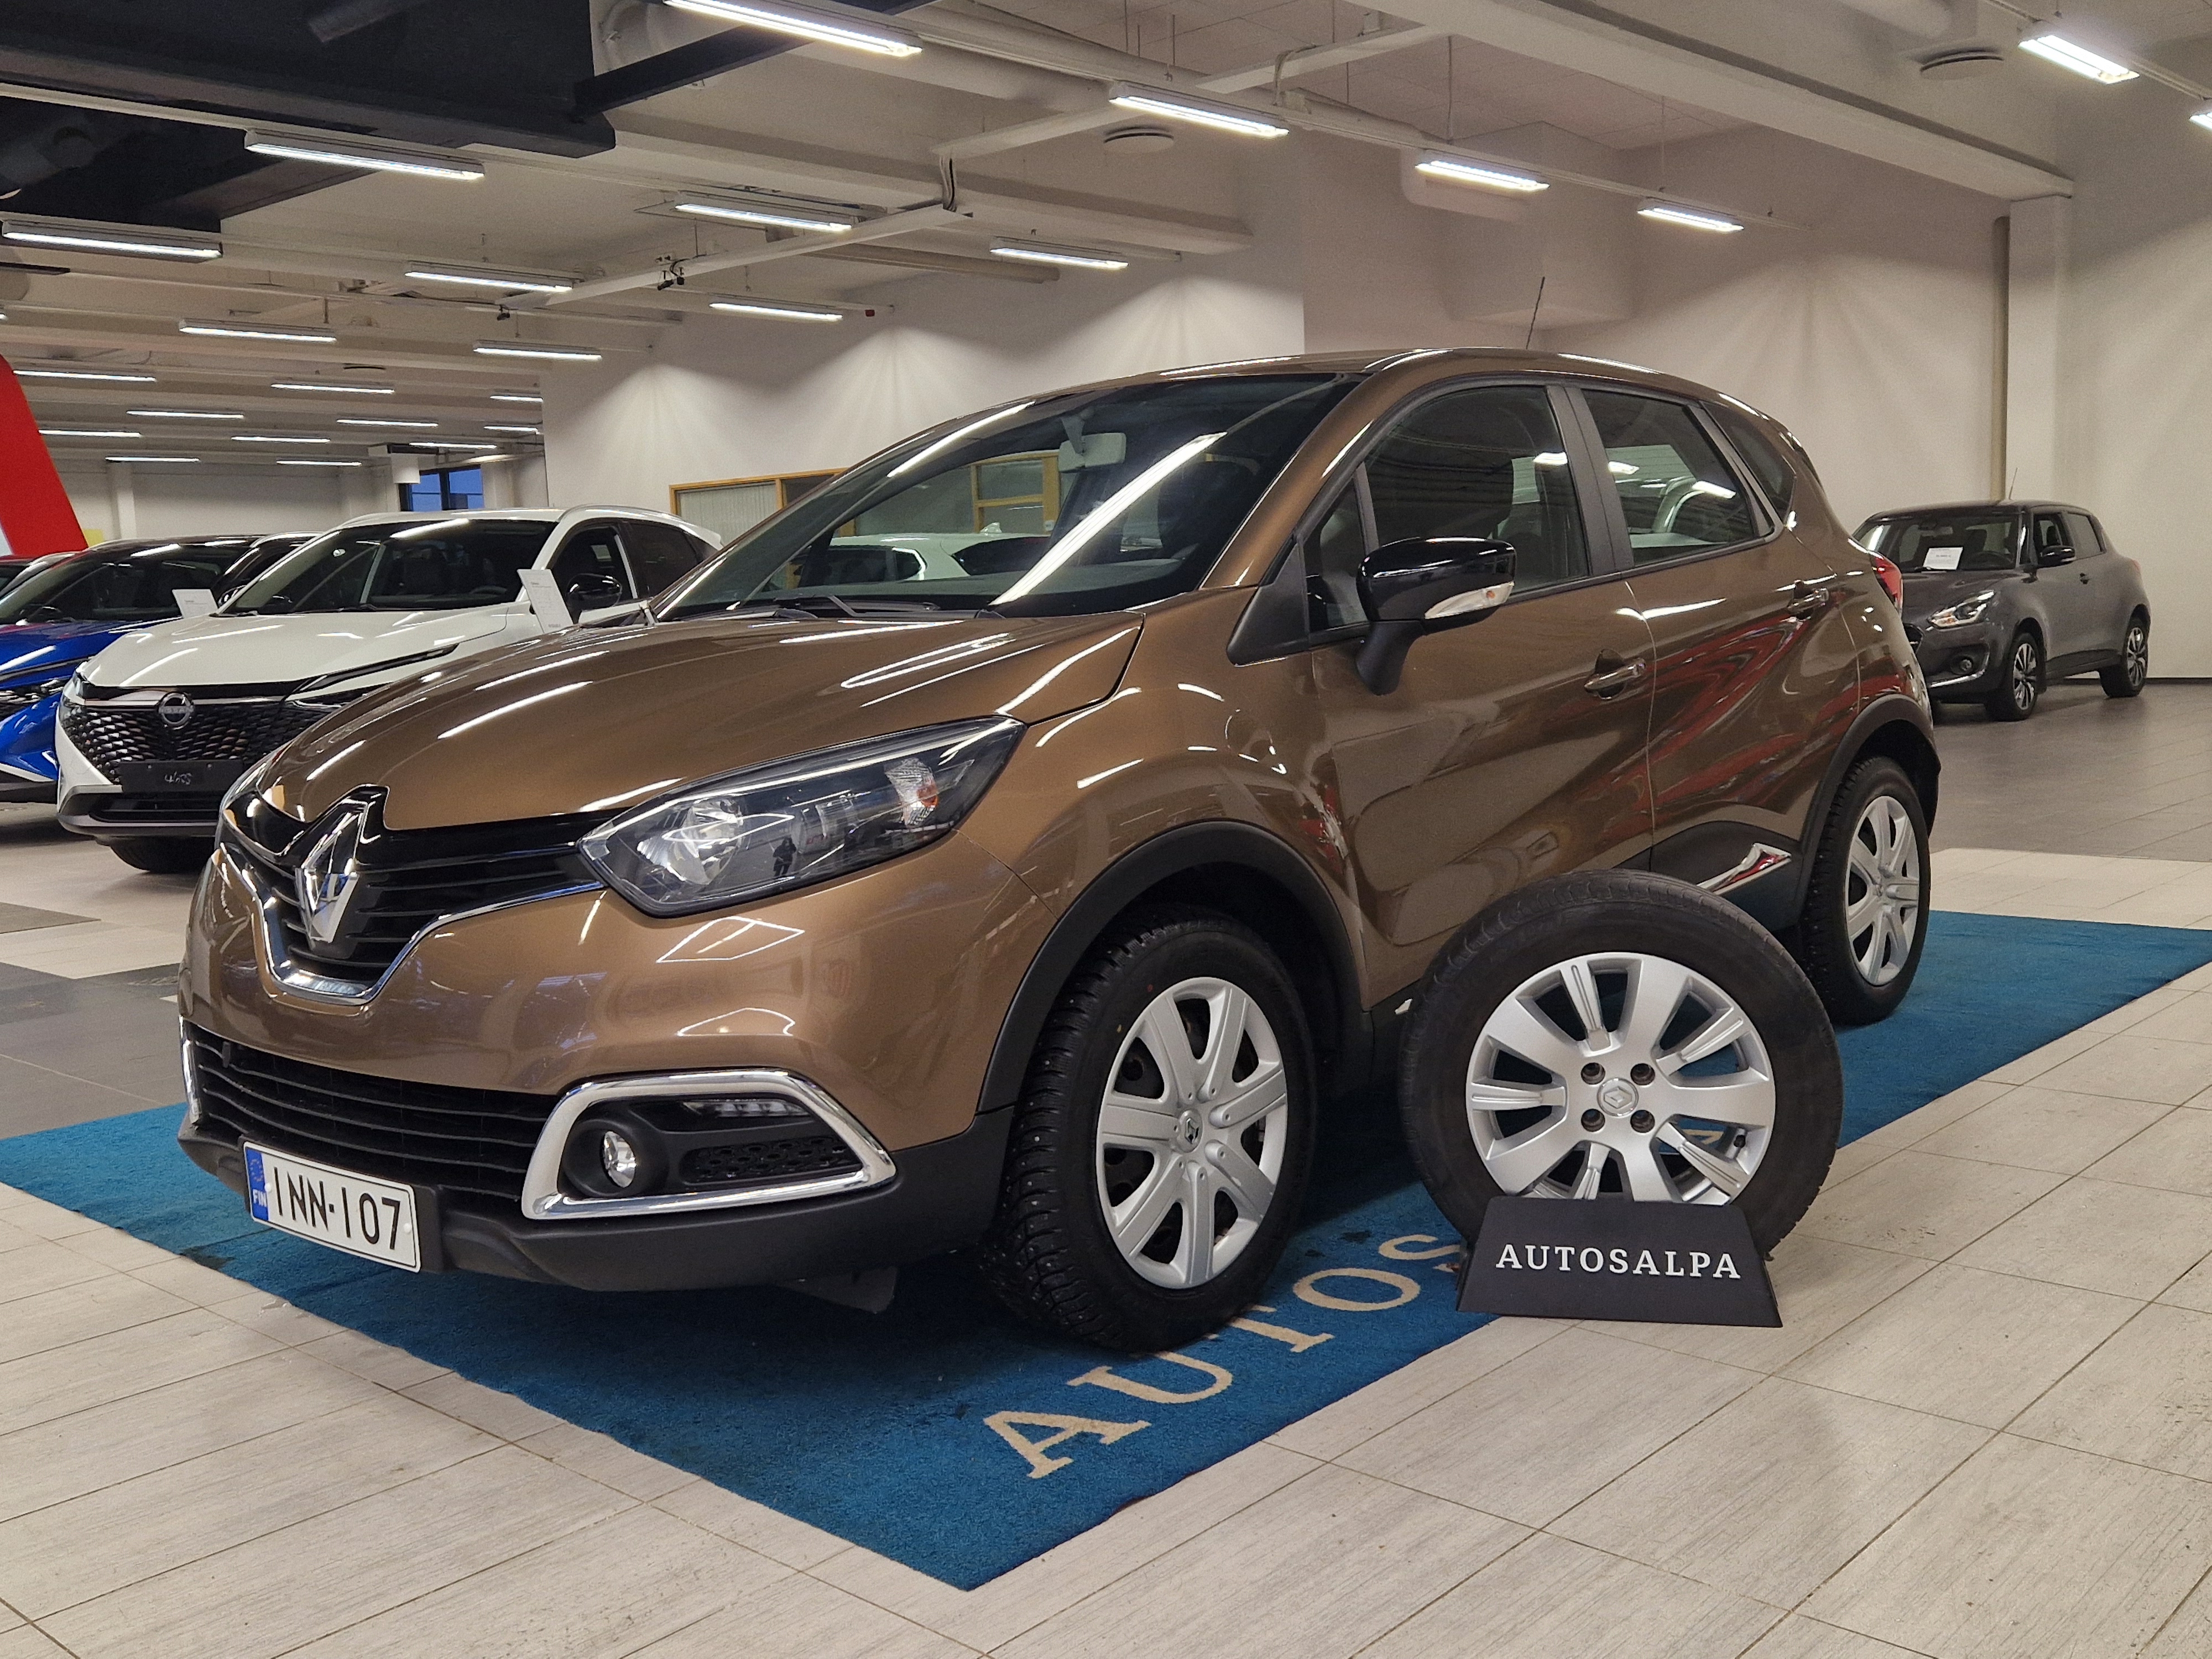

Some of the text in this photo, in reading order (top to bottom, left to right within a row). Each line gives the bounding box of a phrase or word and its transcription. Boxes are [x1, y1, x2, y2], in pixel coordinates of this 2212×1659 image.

[253, 1189, 267, 1207] FIN
[274, 1166, 401, 1250] INN-107
[1495, 1244, 1741, 1279] AUTOSALPA
